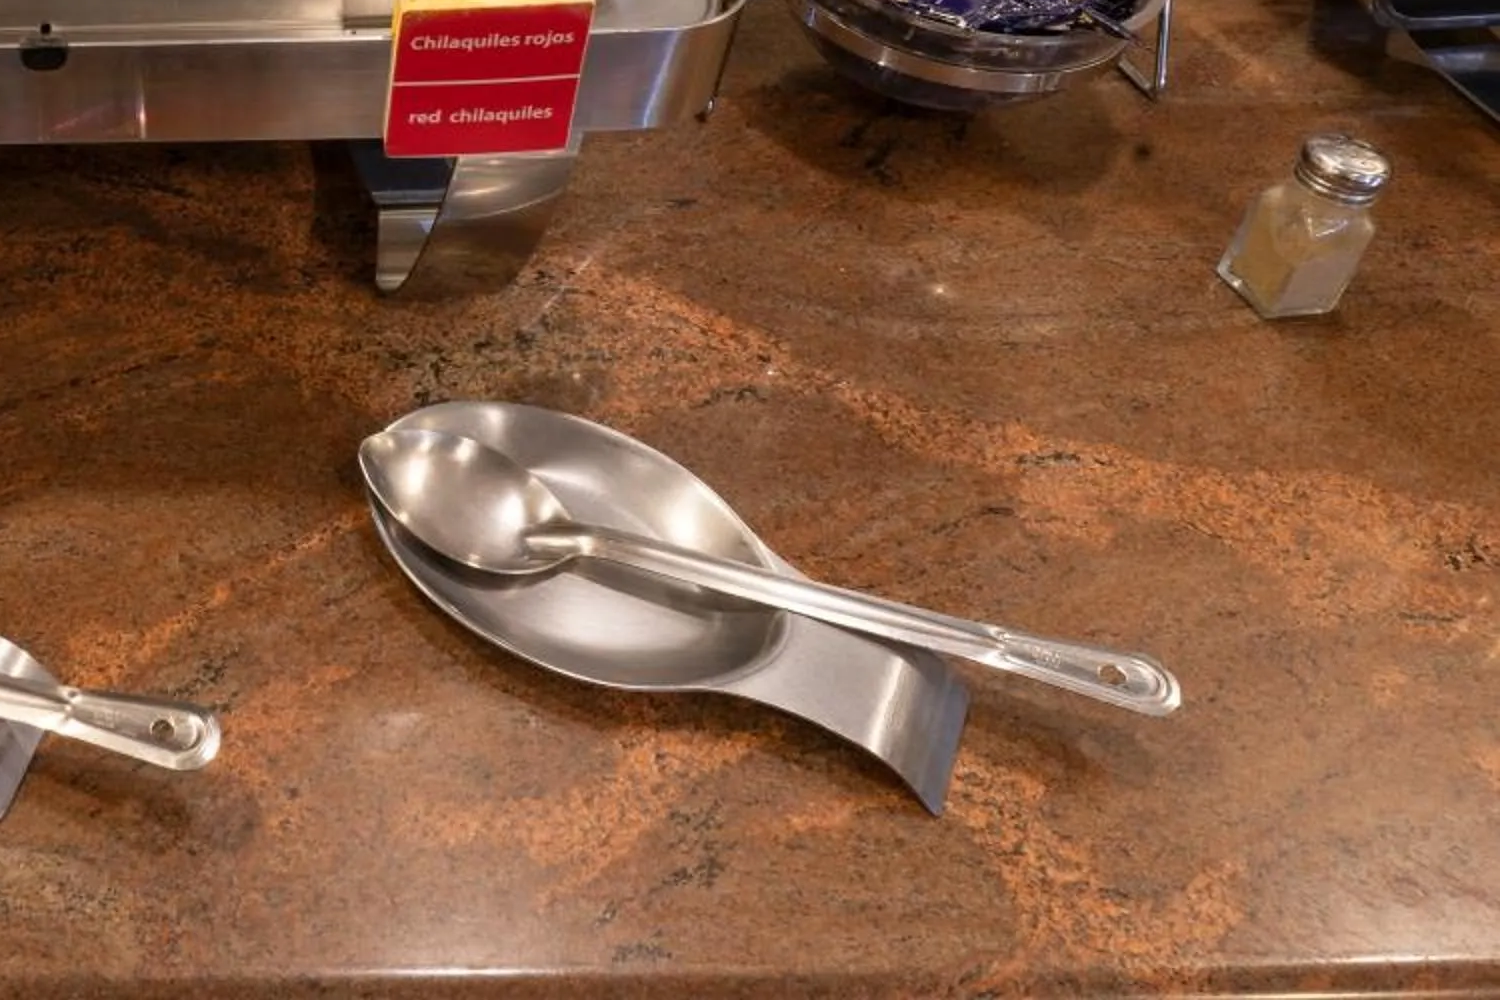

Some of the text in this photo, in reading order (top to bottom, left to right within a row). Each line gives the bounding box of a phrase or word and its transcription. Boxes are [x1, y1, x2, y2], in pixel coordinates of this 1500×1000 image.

[410, 33, 521, 52] Chilaquiles
[408, 104, 553, 125] red chilaquiles
